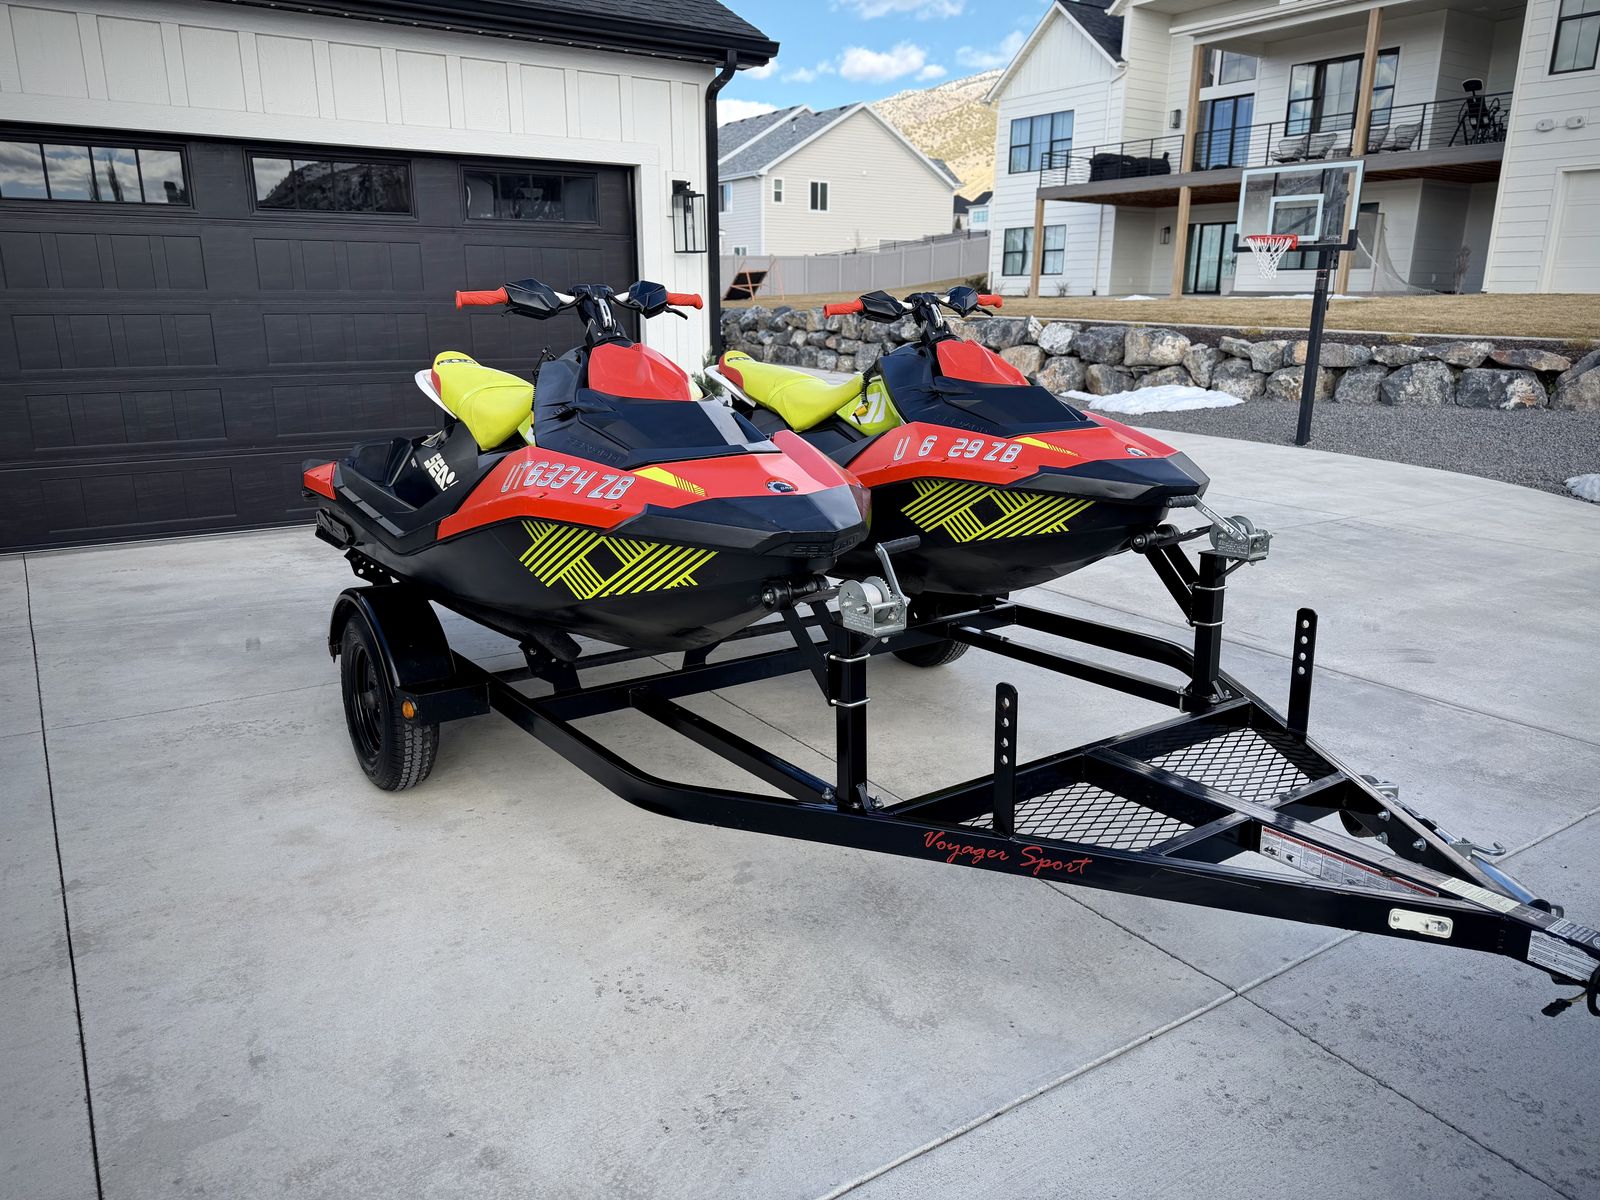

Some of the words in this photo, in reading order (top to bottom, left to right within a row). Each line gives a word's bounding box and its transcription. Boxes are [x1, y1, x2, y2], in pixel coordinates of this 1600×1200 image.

[918, 435, 938, 457] 6
[924, 831, 1010, 864] Voyager
[1019, 846, 1093, 875] Sport
